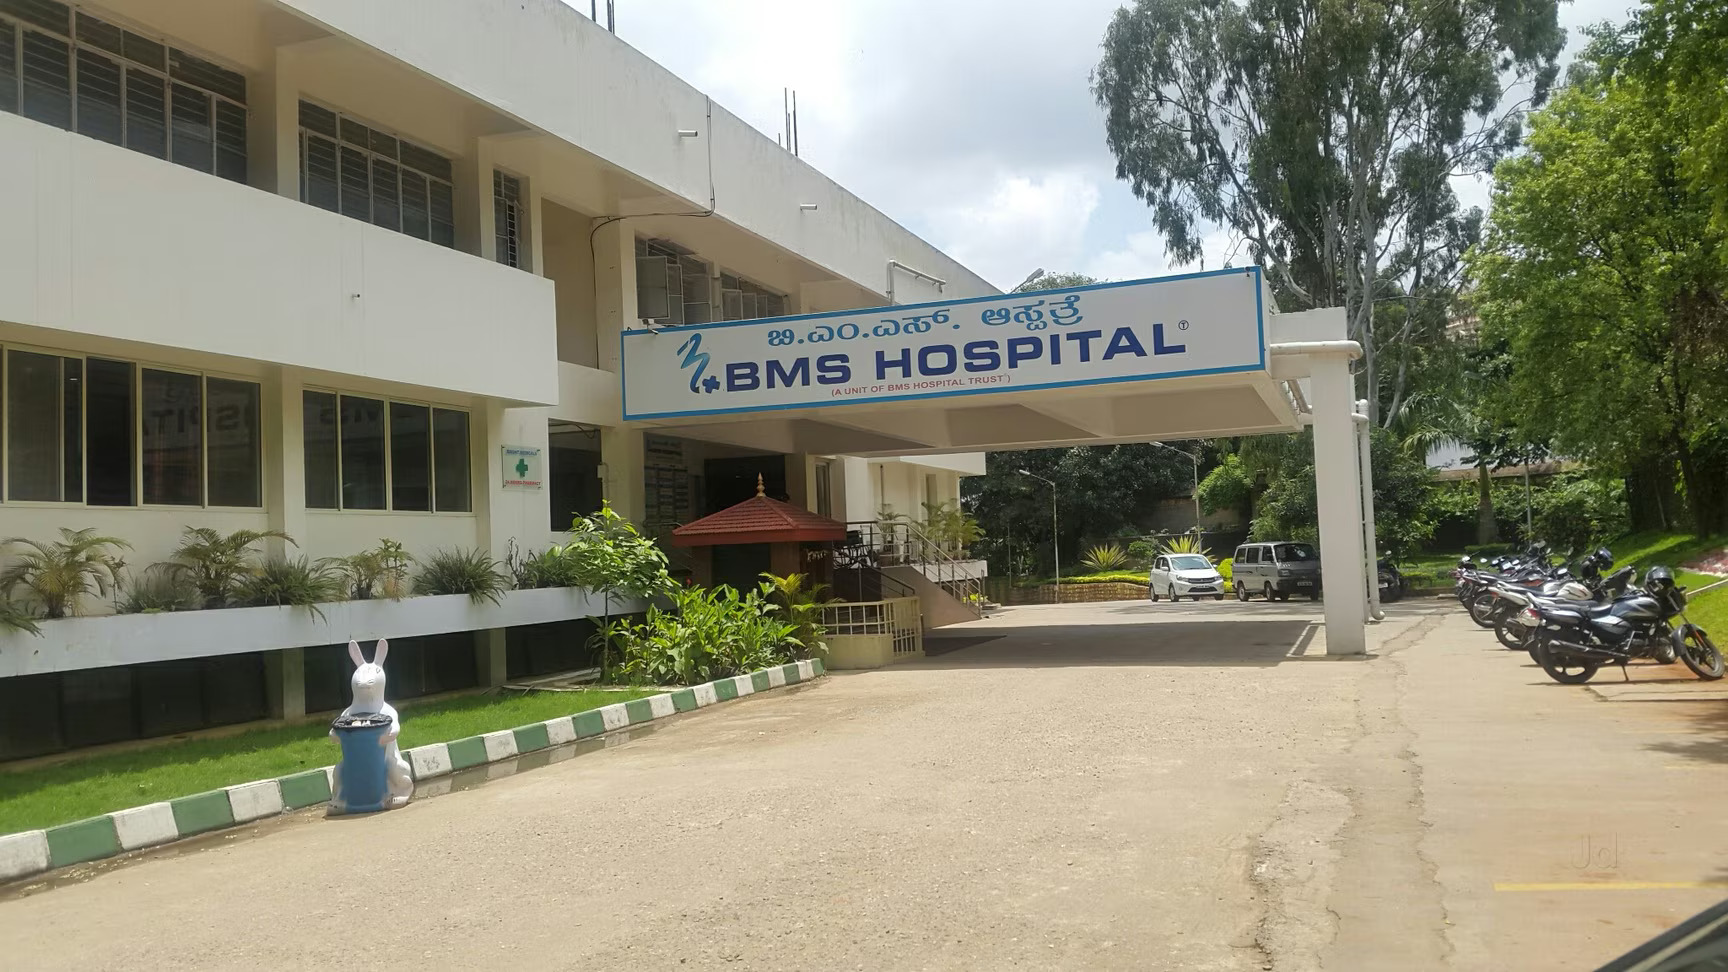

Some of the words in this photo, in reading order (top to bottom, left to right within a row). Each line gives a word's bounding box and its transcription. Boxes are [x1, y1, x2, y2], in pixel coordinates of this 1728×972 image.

[726, 353, 852, 393] BMS
[875, 323, 1187, 381] HOSPITAL
[831, 385, 842, 397] (A
[844, 386, 868, 396] UNIT
[870, 385, 886, 394] OF
[887, 382, 911, 393] BMS
[913, 378, 965, 390] HOSPITAL
